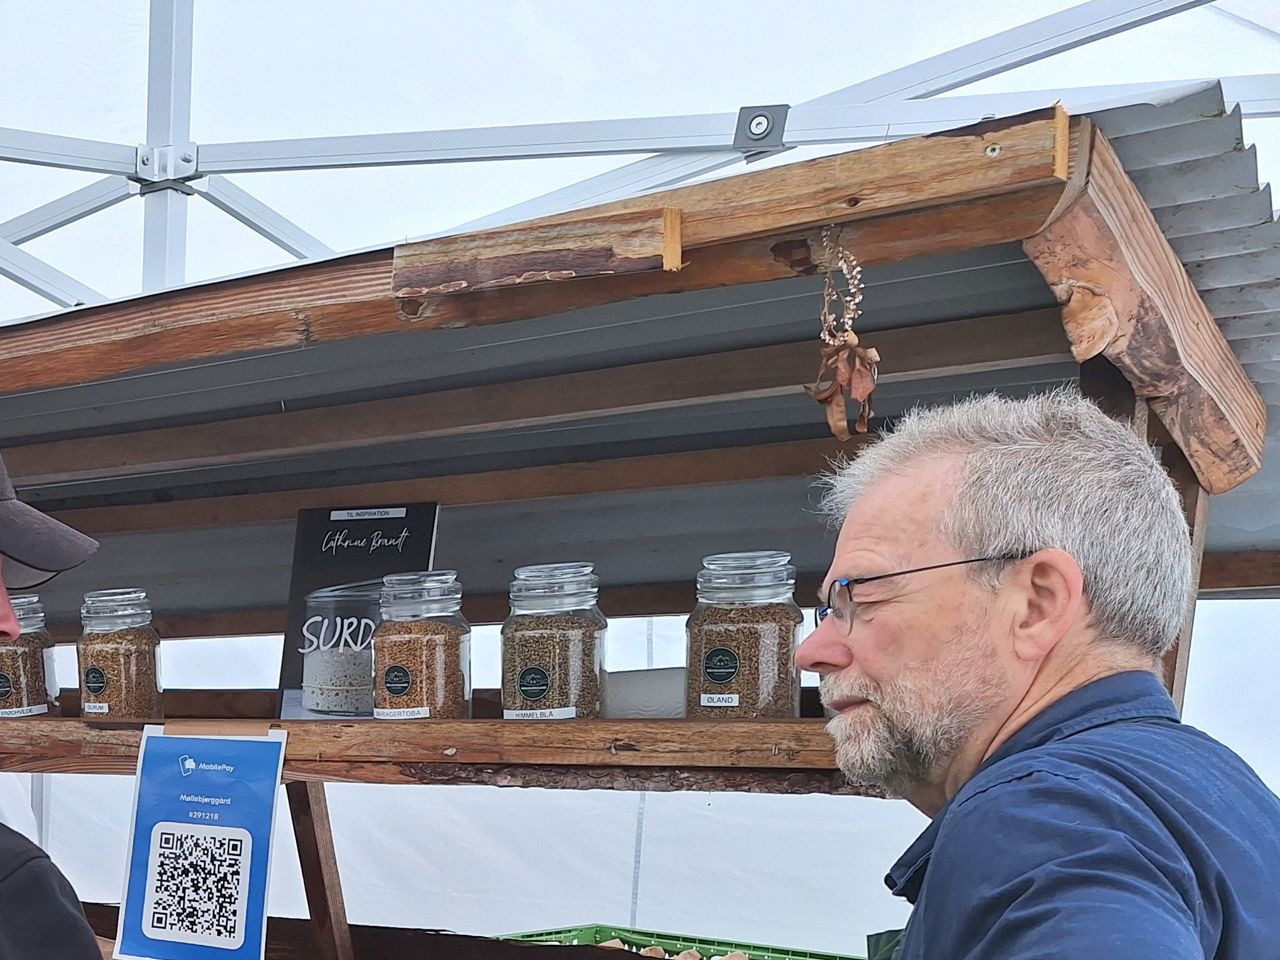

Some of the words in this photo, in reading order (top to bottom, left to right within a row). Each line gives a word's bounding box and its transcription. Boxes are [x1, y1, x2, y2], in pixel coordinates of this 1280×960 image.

[707, 696, 733, 704] ØLAND
[199, 763, 234, 772] MobilePay
[189, 812, 218, 820] #291218
